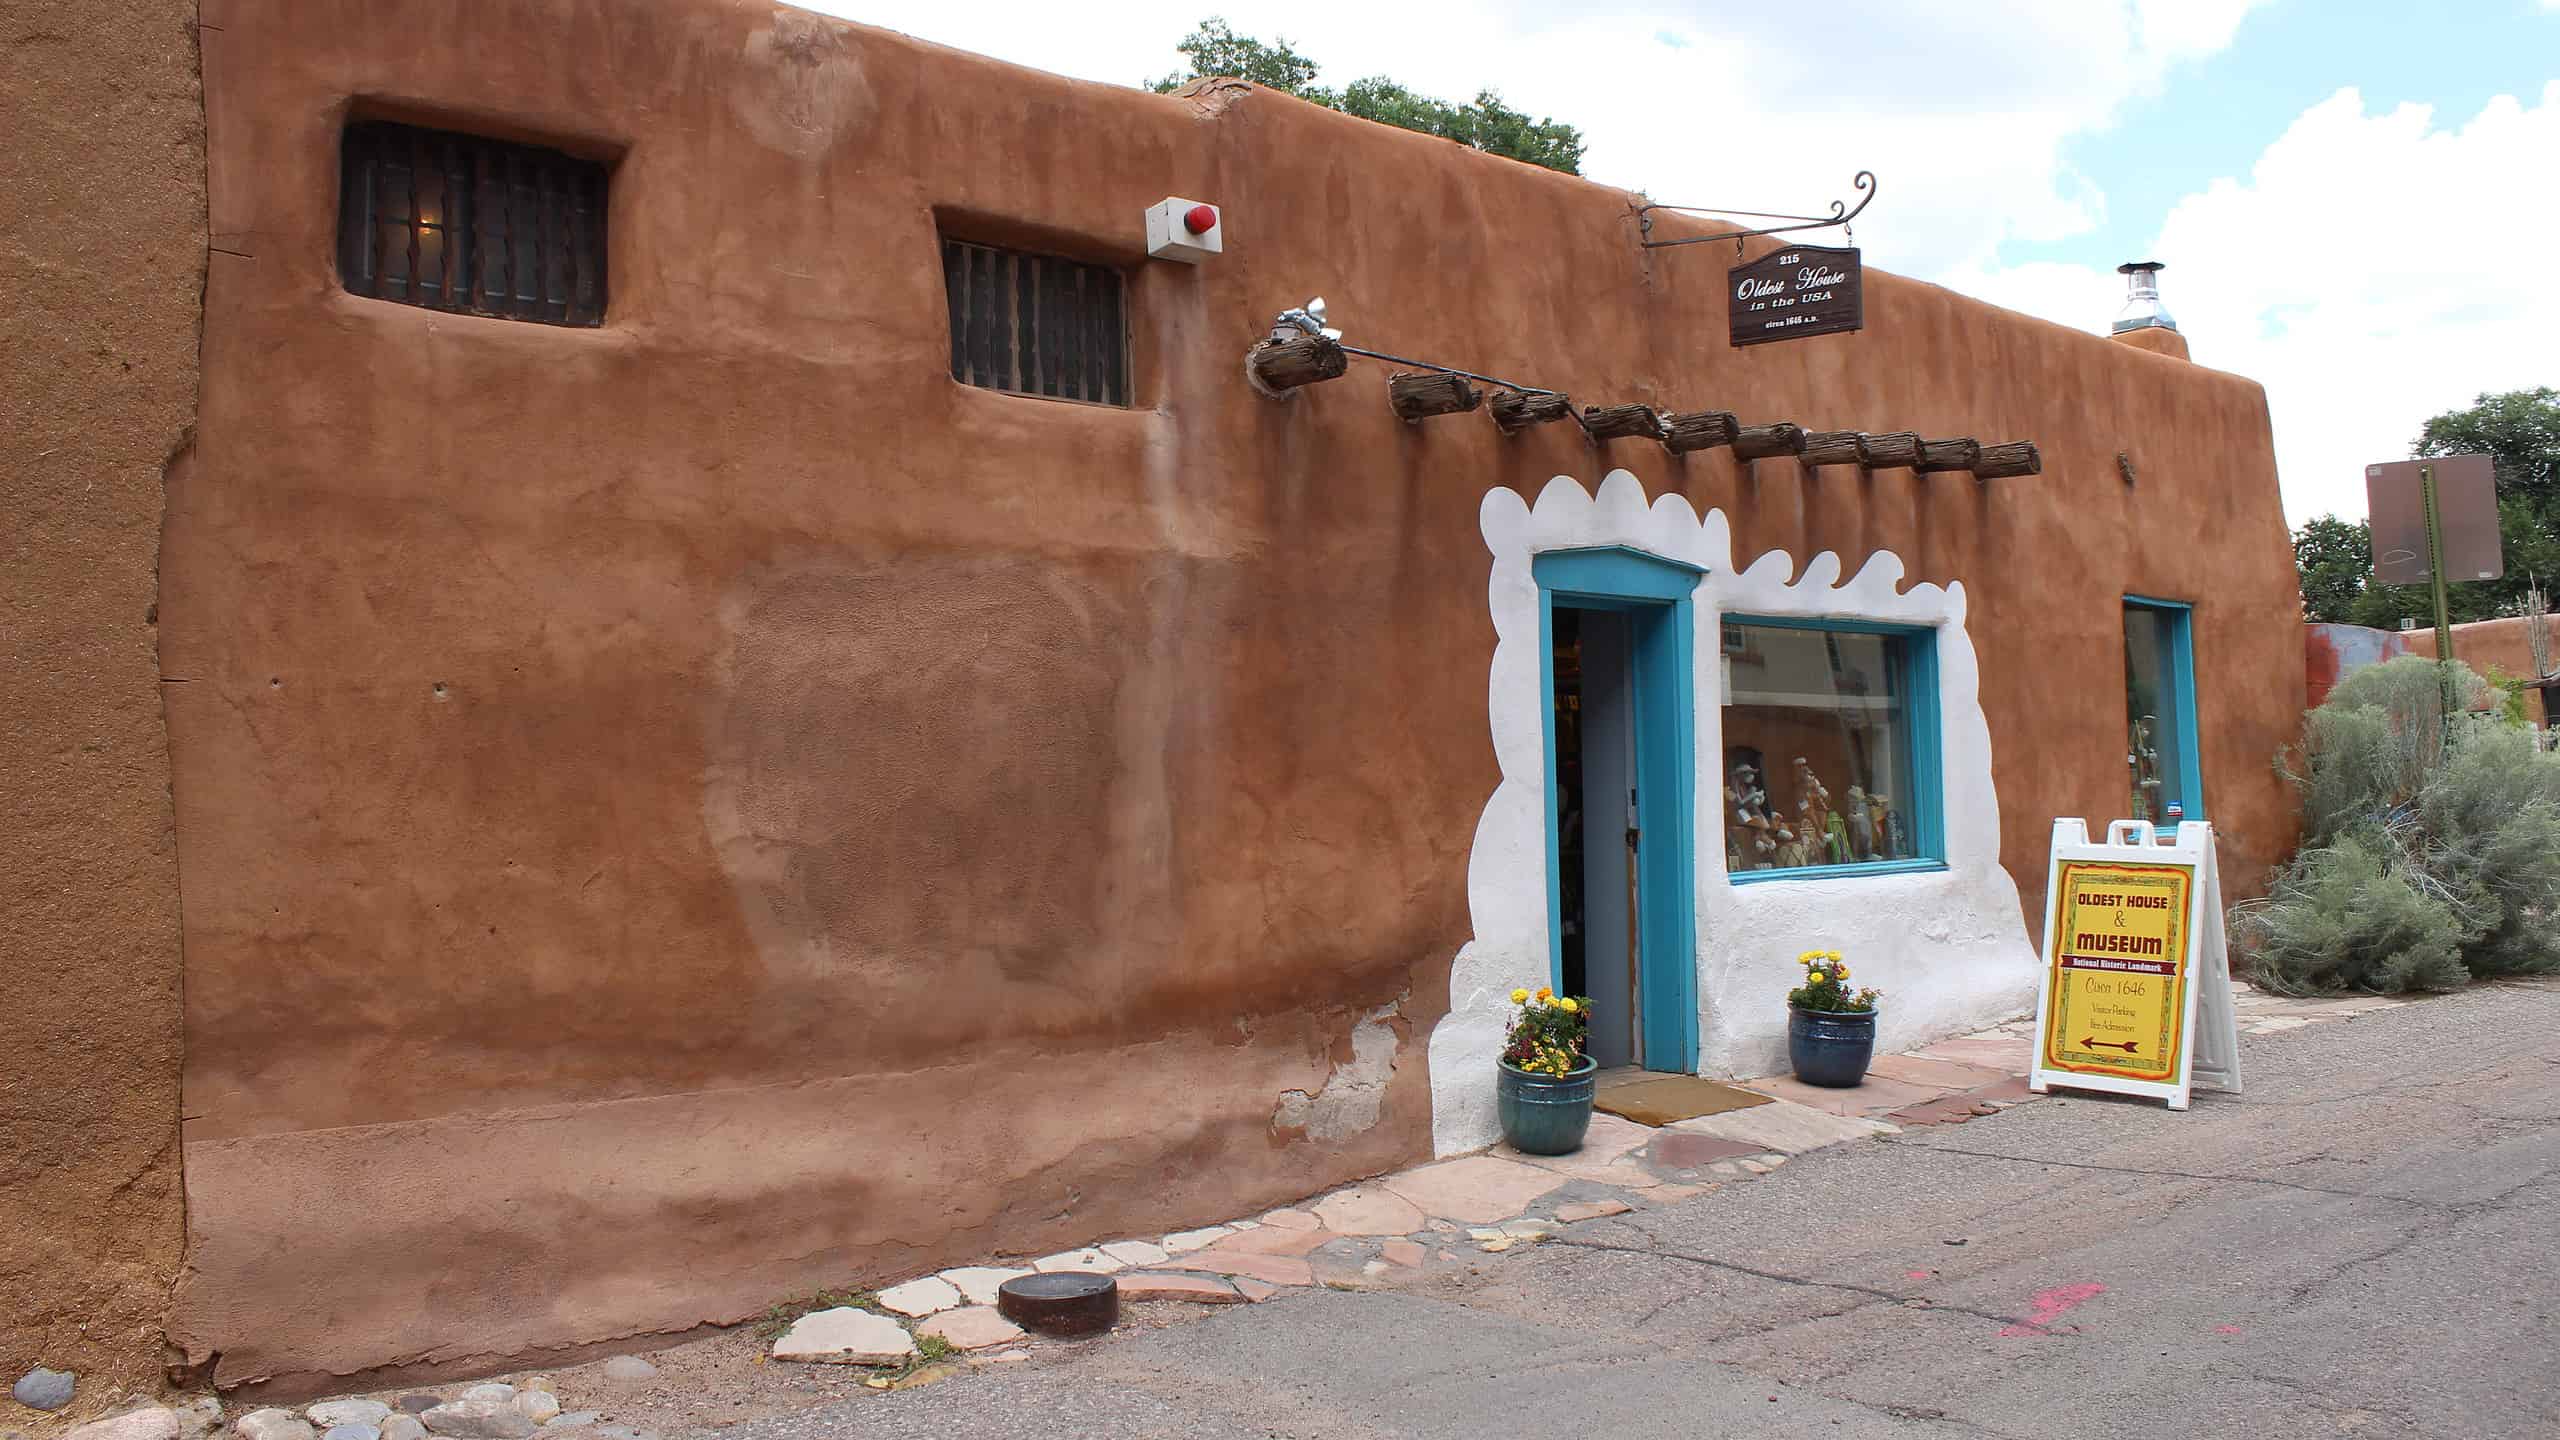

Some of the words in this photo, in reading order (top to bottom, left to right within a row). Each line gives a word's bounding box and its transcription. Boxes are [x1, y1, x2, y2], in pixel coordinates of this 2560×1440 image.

[1780, 254, 1800, 264] 215
[1738, 278, 1785, 300] Oldest
[1796, 266, 1845, 290] House
[1750, 302, 1765, 311] in
[1772, 298, 1795, 308] the
[1802, 291, 1832, 303] USA
[2078, 893, 2122, 906] OLDEST
[2127, 895, 2168, 909] HOUSE
[2113, 910, 2126, 927] &
[2077, 933, 2162, 955] MUSEUM
[2072, 957, 2099, 968] National
[2100, 959, 2127, 969] Historic
[2127, 961, 2162, 972] Landmark
[2117, 980, 2145, 996] 1646
